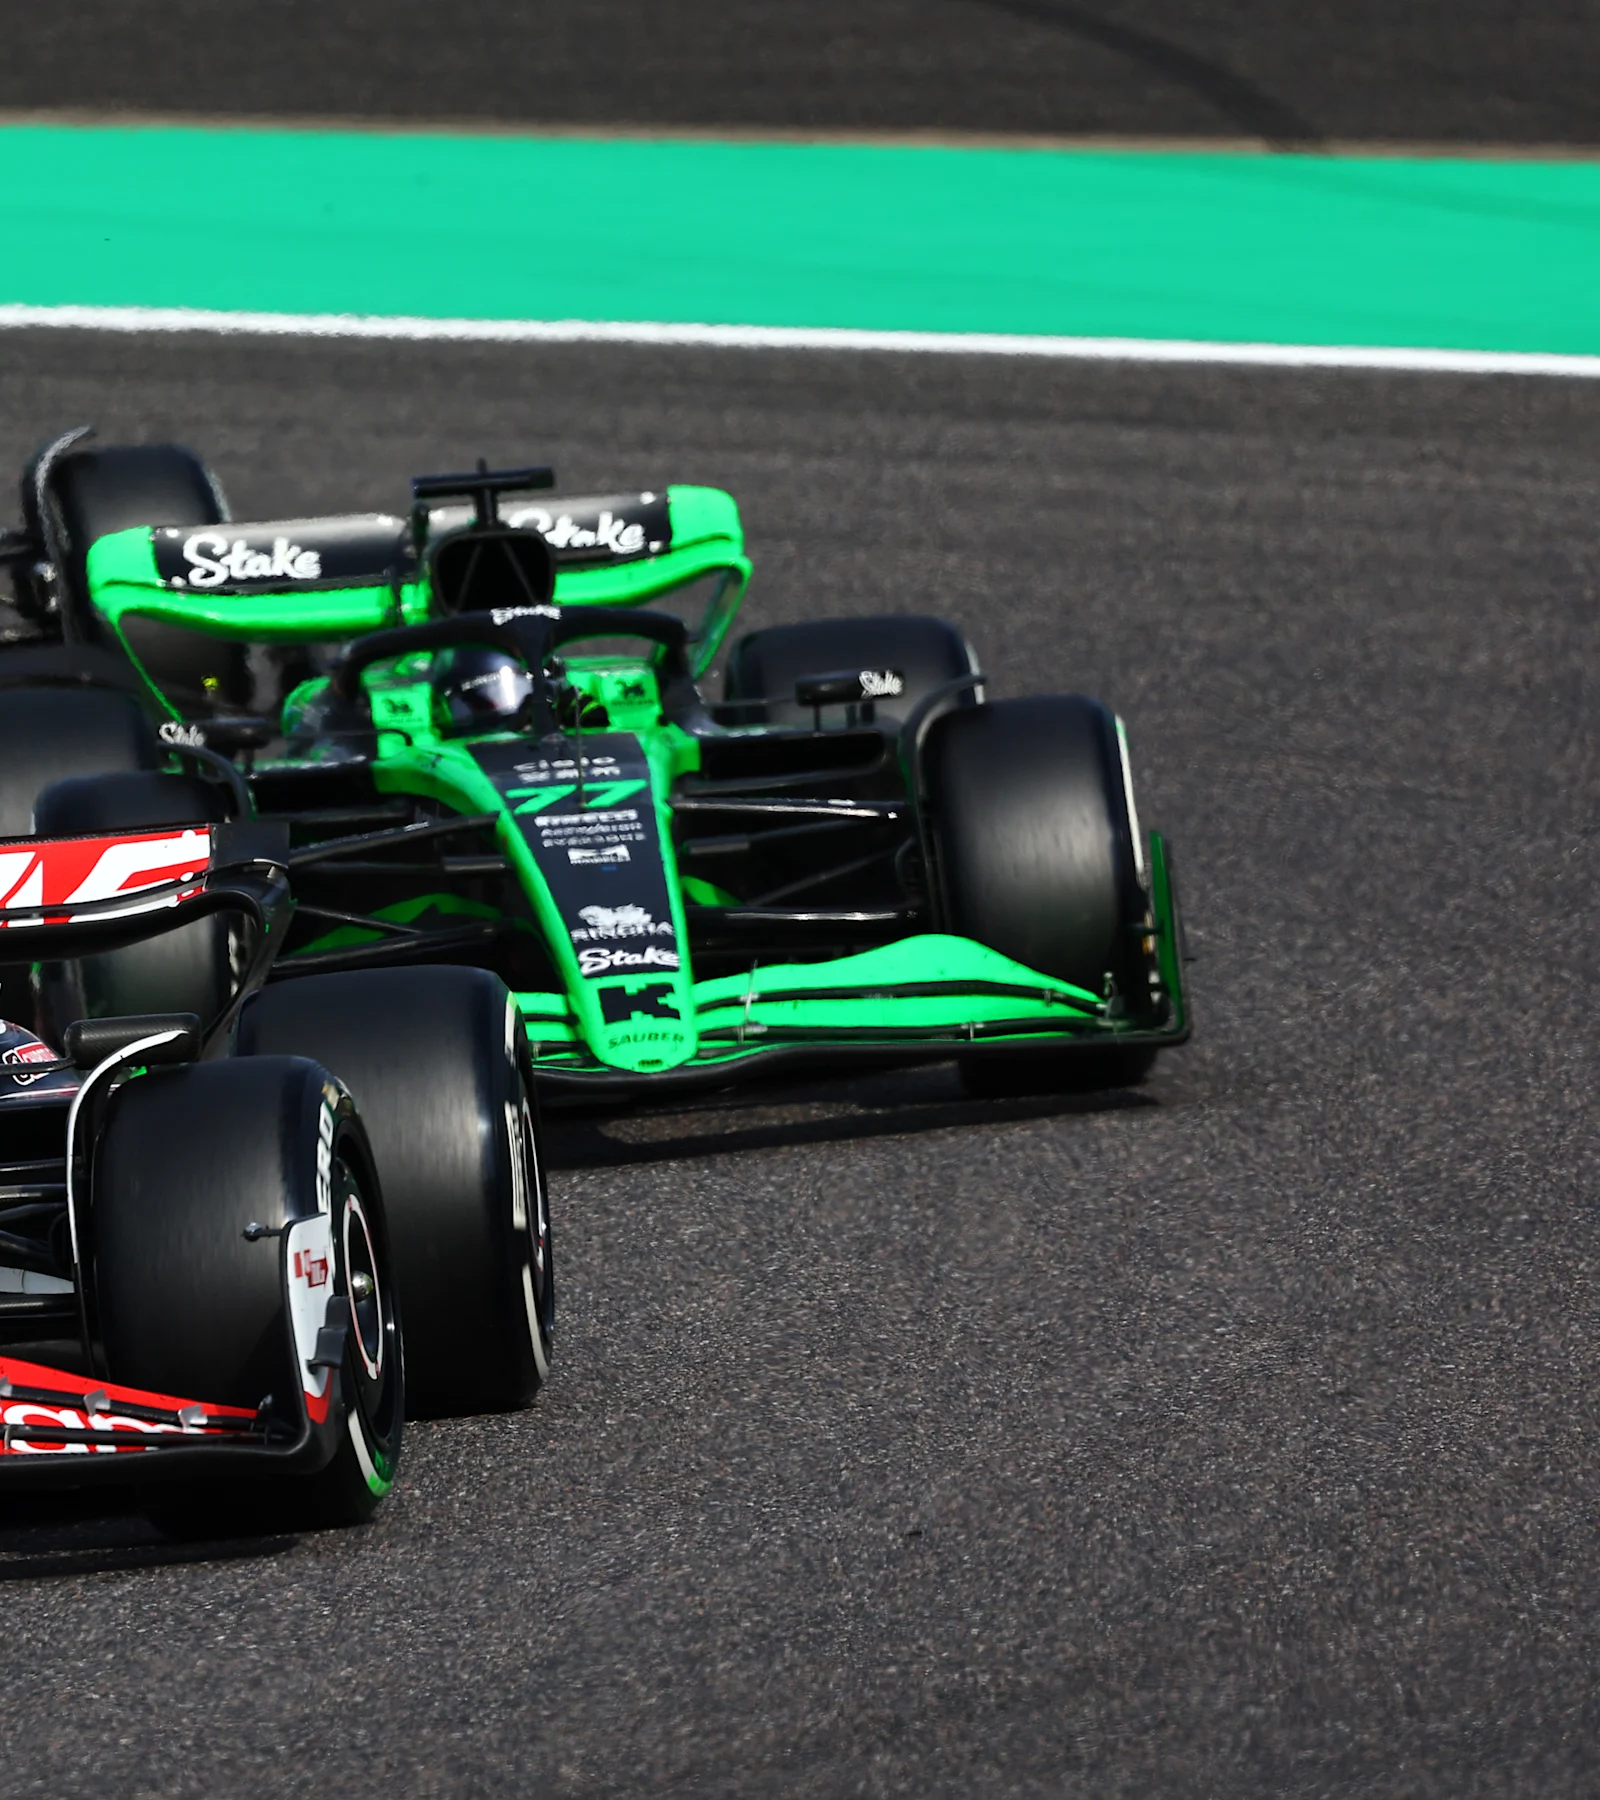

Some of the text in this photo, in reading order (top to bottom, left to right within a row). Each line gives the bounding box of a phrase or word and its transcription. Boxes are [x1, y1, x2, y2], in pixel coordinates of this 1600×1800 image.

[183, 533, 321, 587] Stake
[506, 778, 647, 815] 77
[578, 944, 680, 976] Stake
[609, 1032, 684, 1048] SAUBER
